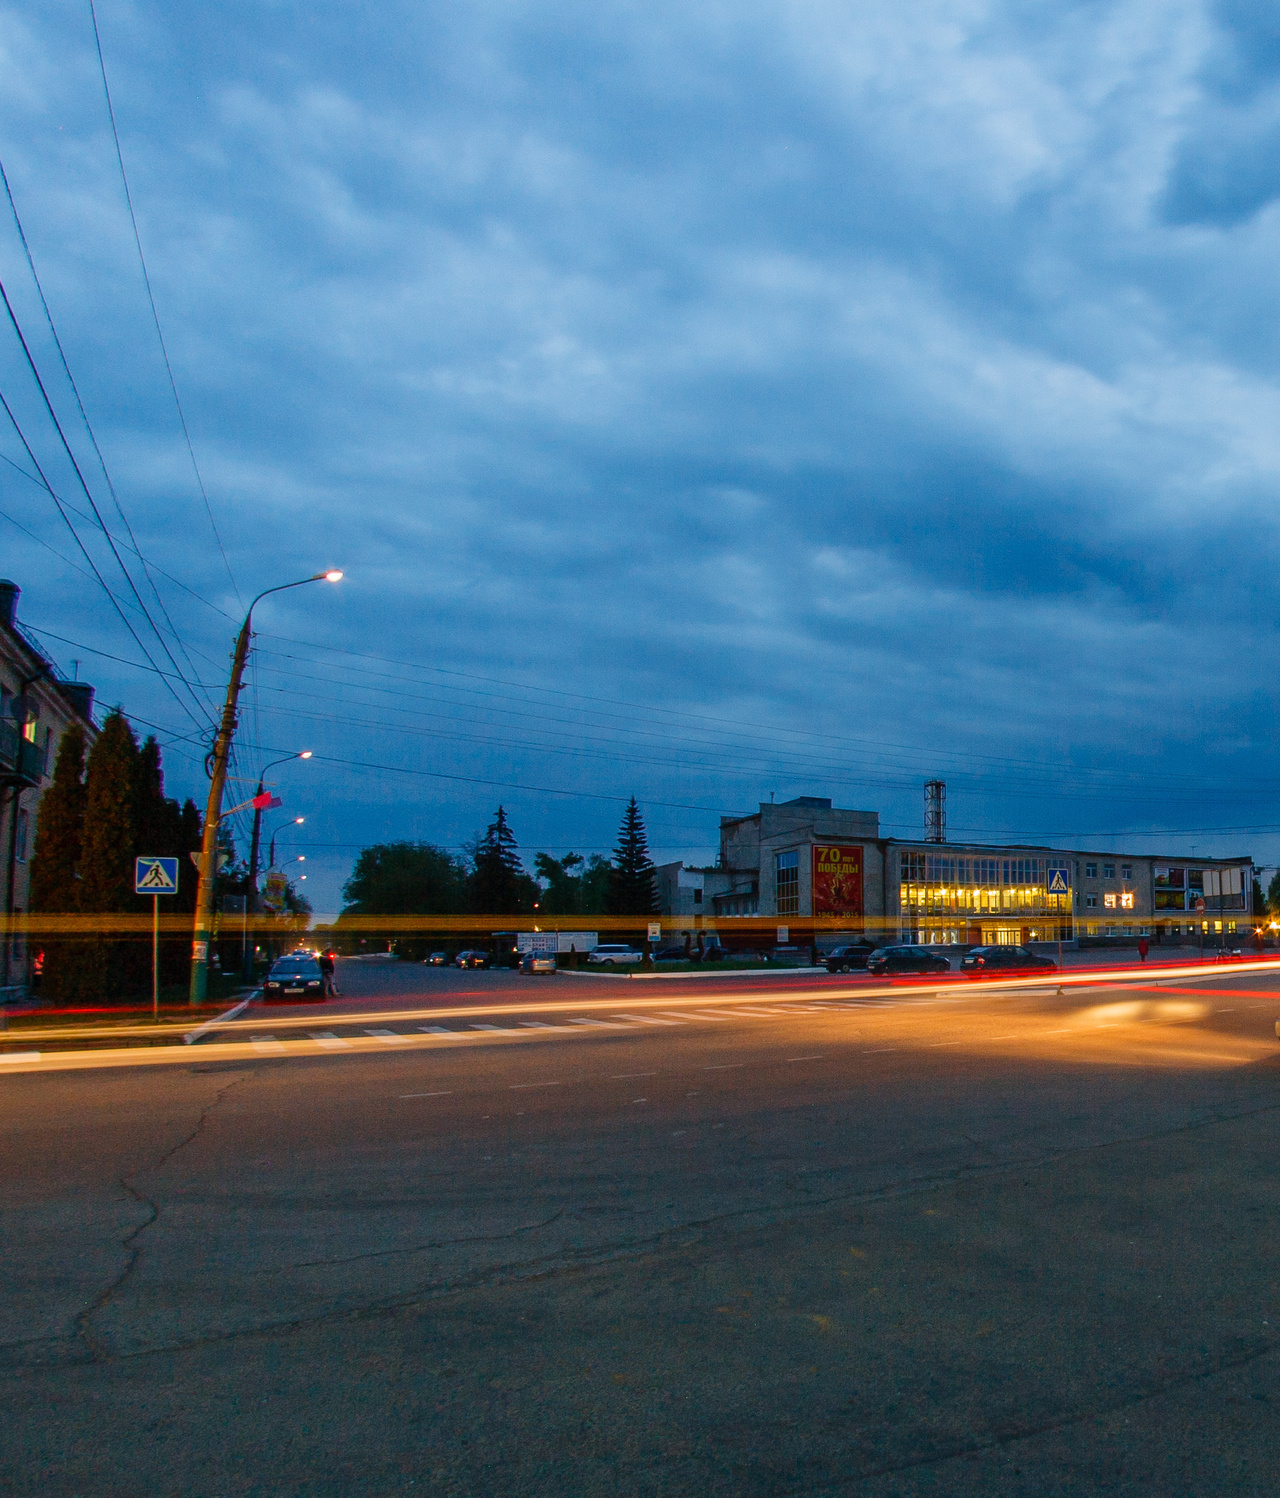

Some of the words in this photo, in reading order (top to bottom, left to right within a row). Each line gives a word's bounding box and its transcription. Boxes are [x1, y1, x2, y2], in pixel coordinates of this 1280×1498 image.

[818, 848, 841, 863] 70
[818, 863, 858, 873] ПОБЕДЫ
[842, 911, 858, 919] 2015
